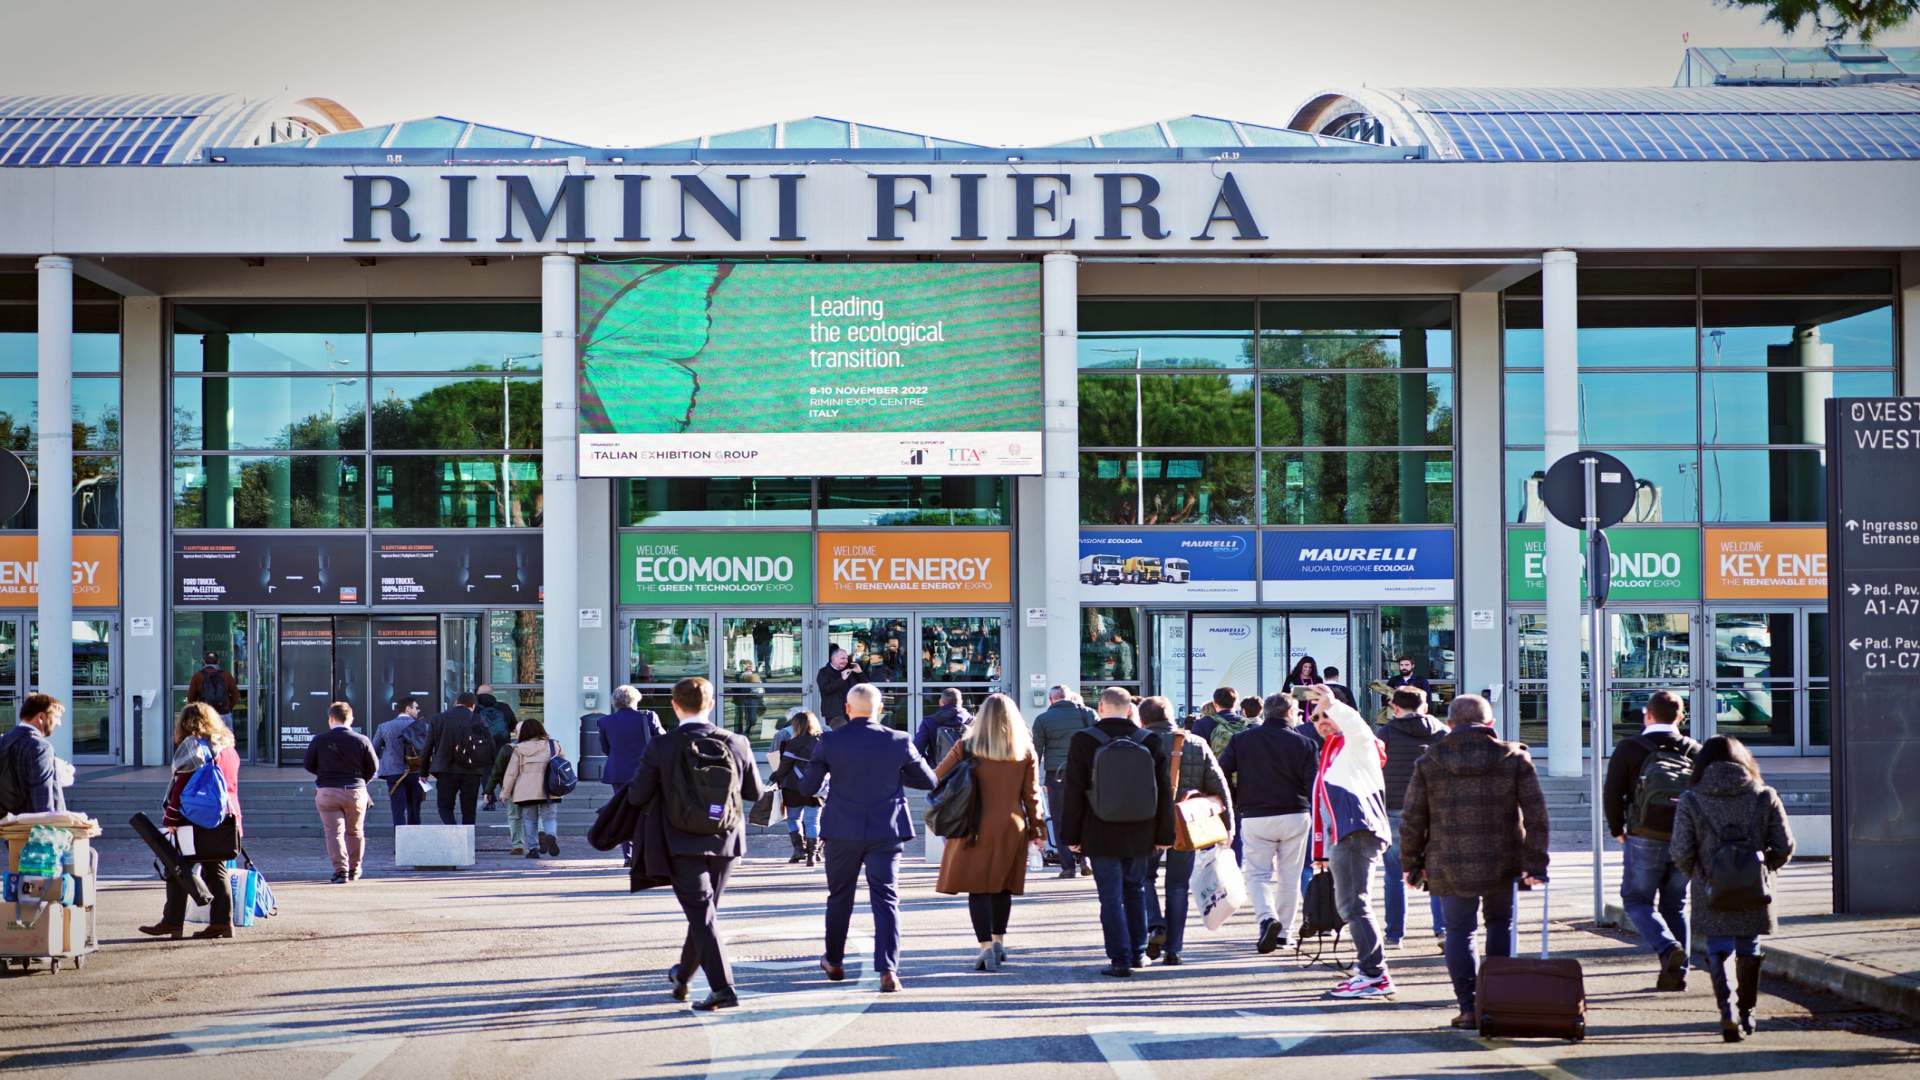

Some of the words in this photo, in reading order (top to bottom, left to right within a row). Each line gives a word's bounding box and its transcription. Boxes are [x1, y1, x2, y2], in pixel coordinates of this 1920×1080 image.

[343, 174, 807, 243] RIMINI
[866, 171, 1270, 241] FIERA
[810, 295, 884, 320] Leading
[809, 321, 840, 342] the
[847, 321, 945, 346] ecological
[809, 348, 905, 368] transition.
[809, 386, 833, 395] 8-10
[835, 386, 899, 395] NOVEMBER
[901, 386, 928, 395] 2022
[810, 397, 844, 406] RIMINI
[846, 397, 877, 406] EXPO
[880, 397, 924, 406] CENTRE
[809, 409, 839, 418] ITALY
[1854, 429, 1920, 449] WEST
[641, 450, 711, 460] EXHIBITION
[714, 450, 759, 460] GROUP
[1862, 519, 1918, 533] Ingresso
[1181, 540, 1237, 548] MAURELLI
[1862, 533, 1920, 545] Entrance
[636, 545, 678, 556] WELCOME
[833, 545, 877, 556] WELCOME
[1720, 541, 1764, 552] WELCOME
[1298, 548, 1418, 561] MAURELLI
[636, 556, 794, 582] ECOMONDO
[833, 557, 883, 581] KEY
[890, 557, 992, 581] ENERGY
[1302, 565, 1330, 573] NUOVA
[1373, 564, 1415, 572] ECOLOGIA
[1720, 553, 1771, 577] KEY
[637, 584, 656, 592] THE
[658, 584, 693, 592] GREEN
[695, 584, 763, 592] TECHNOLOGY
[765, 584, 793, 592] EXPO
[834, 582, 852, 591] THE
[855, 582, 919, 591] RENEWABLE
[921, 582, 962, 591] ENERGY
[964, 582, 993, 591] EXPO
[1526, 580, 1544, 588] THE
[1653, 580, 1681, 588] EXPO
[1721, 578, 1741, 586] THE
[1743, 578, 1806, 586] RENEWABLE
[1864, 583, 1891, 595] Pad.
[1895, 583, 1920, 595] Pav.
[1864, 598, 1919, 615] A1-A7
[1865, 637, 1892, 649] Pad.
[1895, 637, 1920, 649] Pav.
[1866, 652, 1920, 669] C1-C7
